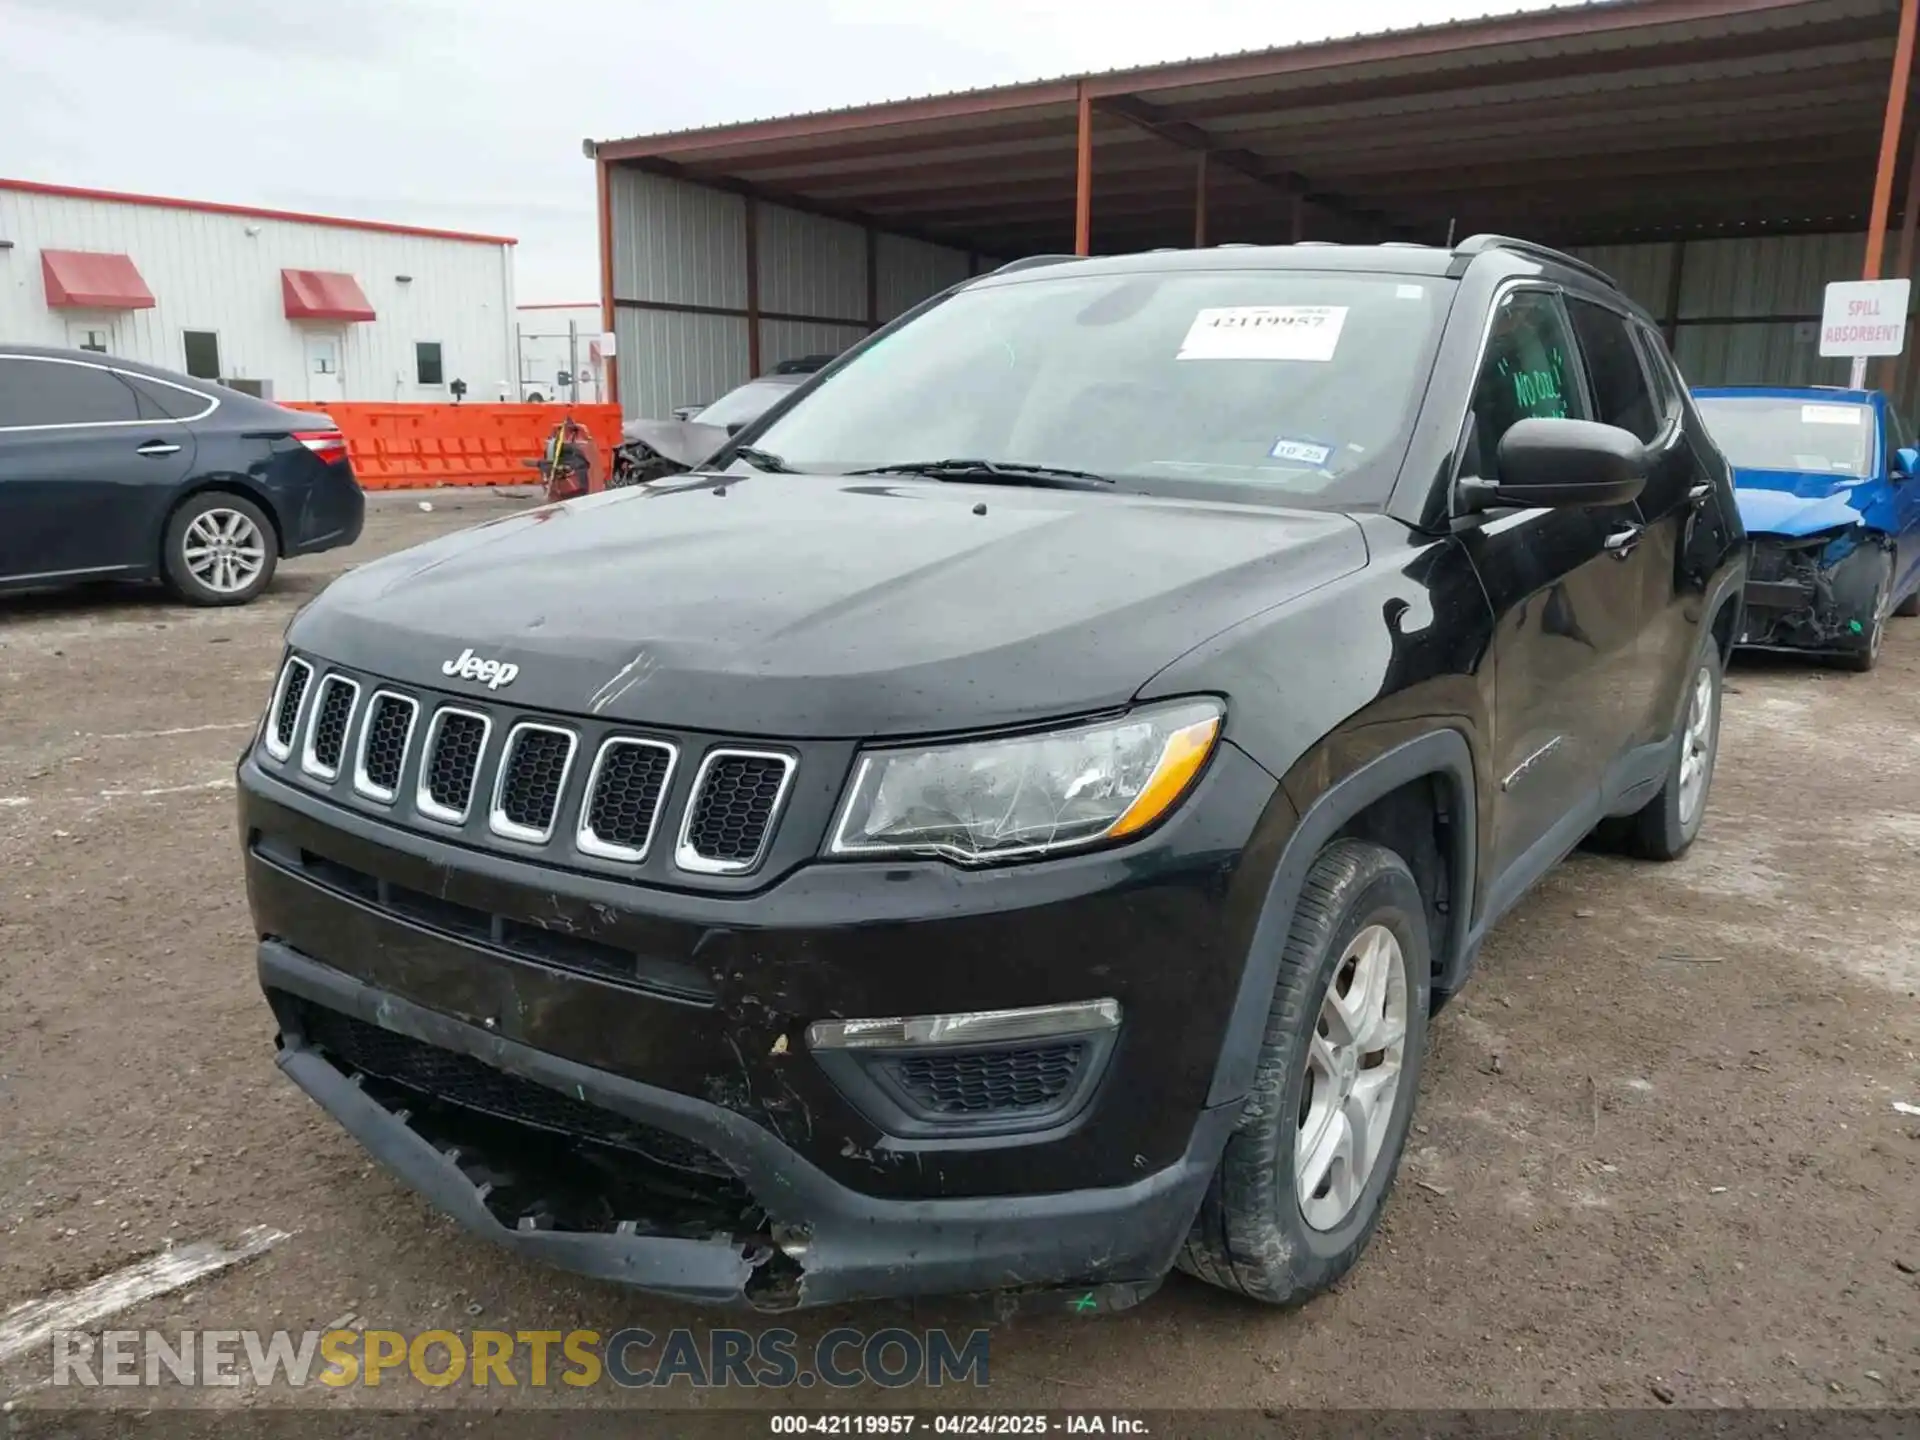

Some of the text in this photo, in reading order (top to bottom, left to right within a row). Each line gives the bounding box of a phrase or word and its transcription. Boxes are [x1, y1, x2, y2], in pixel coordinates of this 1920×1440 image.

[1848, 299, 1880, 316] SPILL
[1825, 324, 1900, 342] ABSORBENT
[442, 648, 519, 690] Jeep
